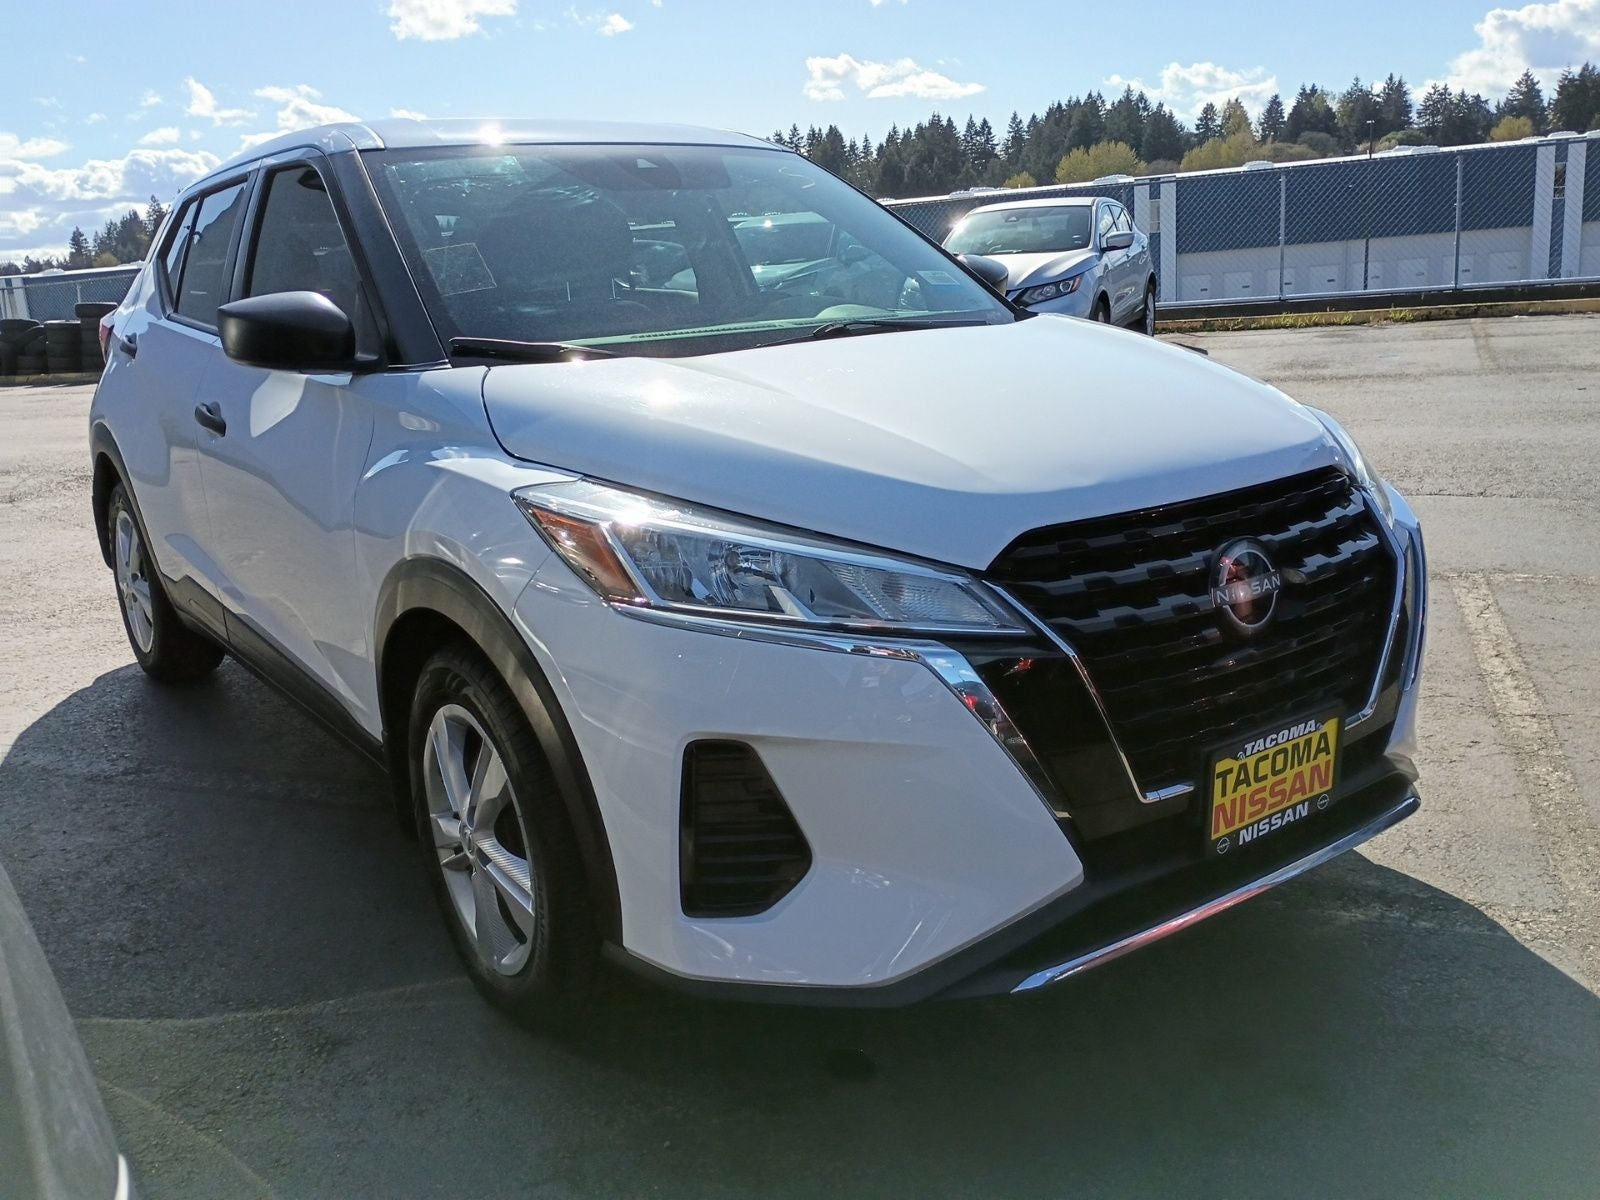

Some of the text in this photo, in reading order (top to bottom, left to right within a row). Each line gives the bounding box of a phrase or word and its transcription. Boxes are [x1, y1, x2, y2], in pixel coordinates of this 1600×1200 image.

[1216, 573, 1281, 603] NISAN
[1244, 720, 1316, 756] TACOMA
[1216, 731, 1331, 798] TACOMA
[1212, 759, 1332, 835] NISSAN
[1238, 801, 1309, 845] NISSAN
